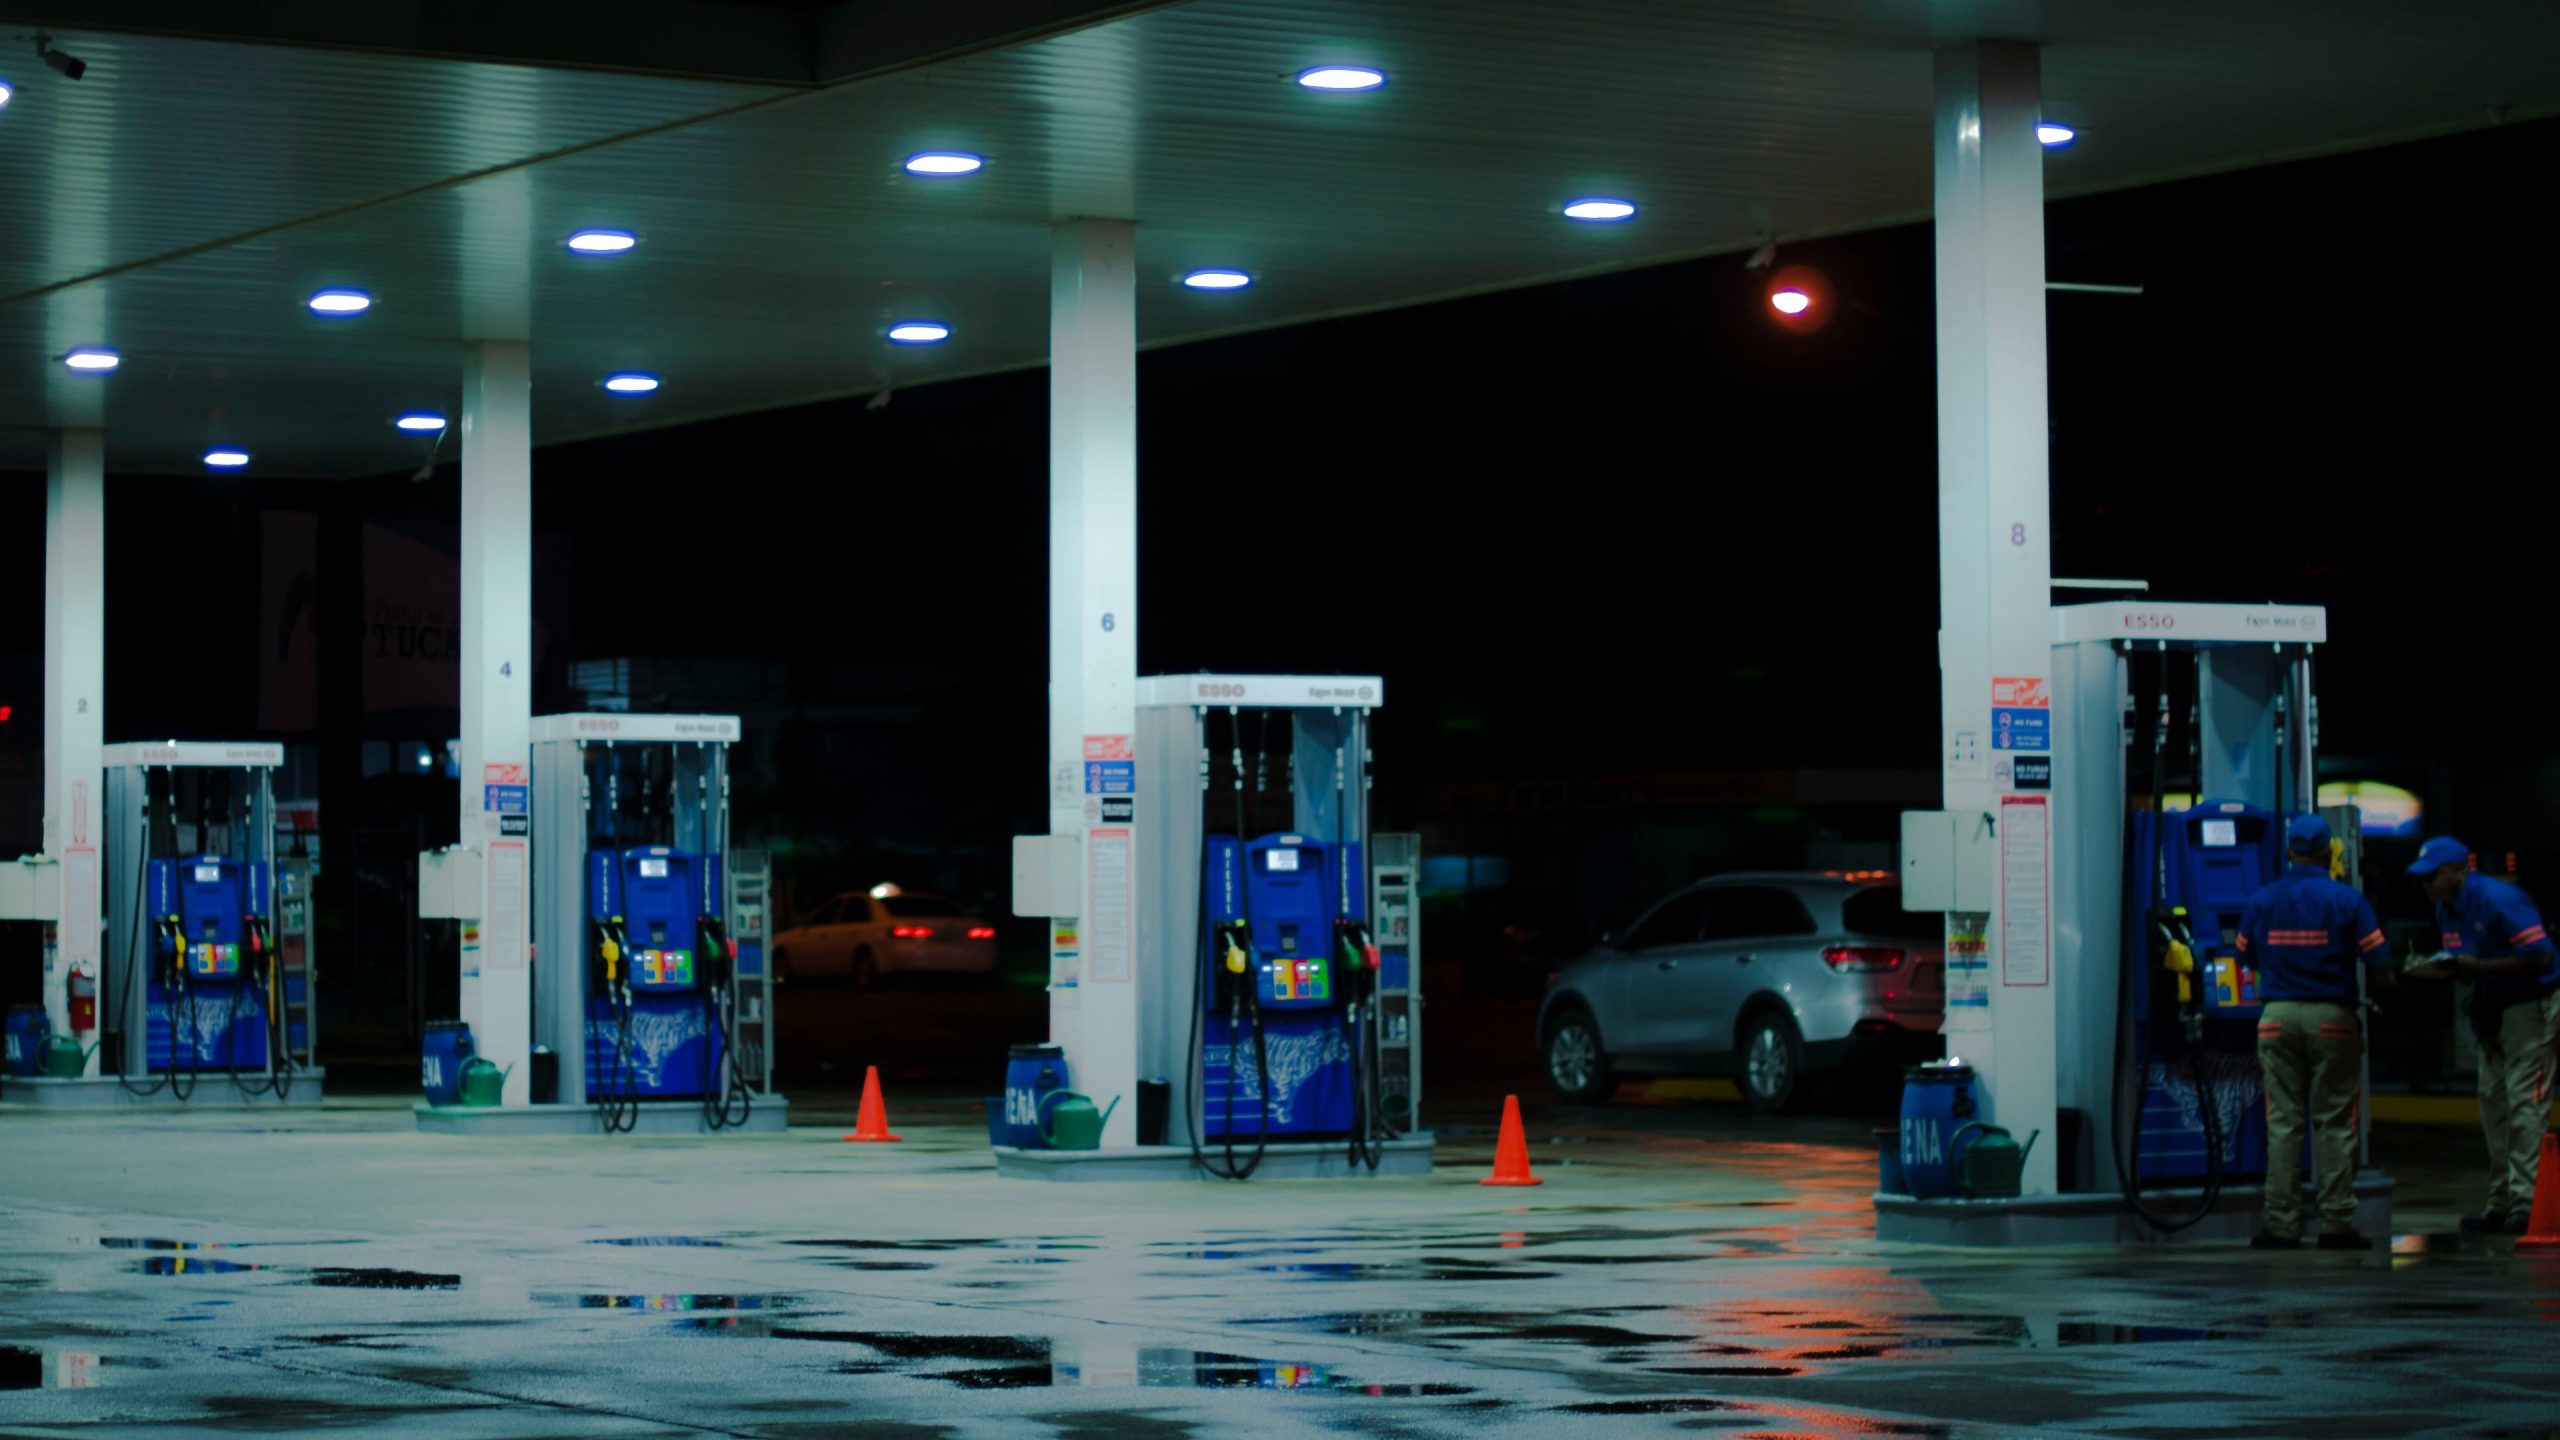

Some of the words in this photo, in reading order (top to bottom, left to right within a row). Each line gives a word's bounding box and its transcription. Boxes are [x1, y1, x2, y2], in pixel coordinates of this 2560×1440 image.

[2011, 522, 2026, 547] 8
[1101, 612, 1115, 632] 6
[2124, 615, 2175, 629] ESSO
[500, 661, 511, 678] 4
[1198, 683, 1246, 698] ESSO
[78, 698, 88, 714] 2
[579, 719, 620, 731] ESSO
